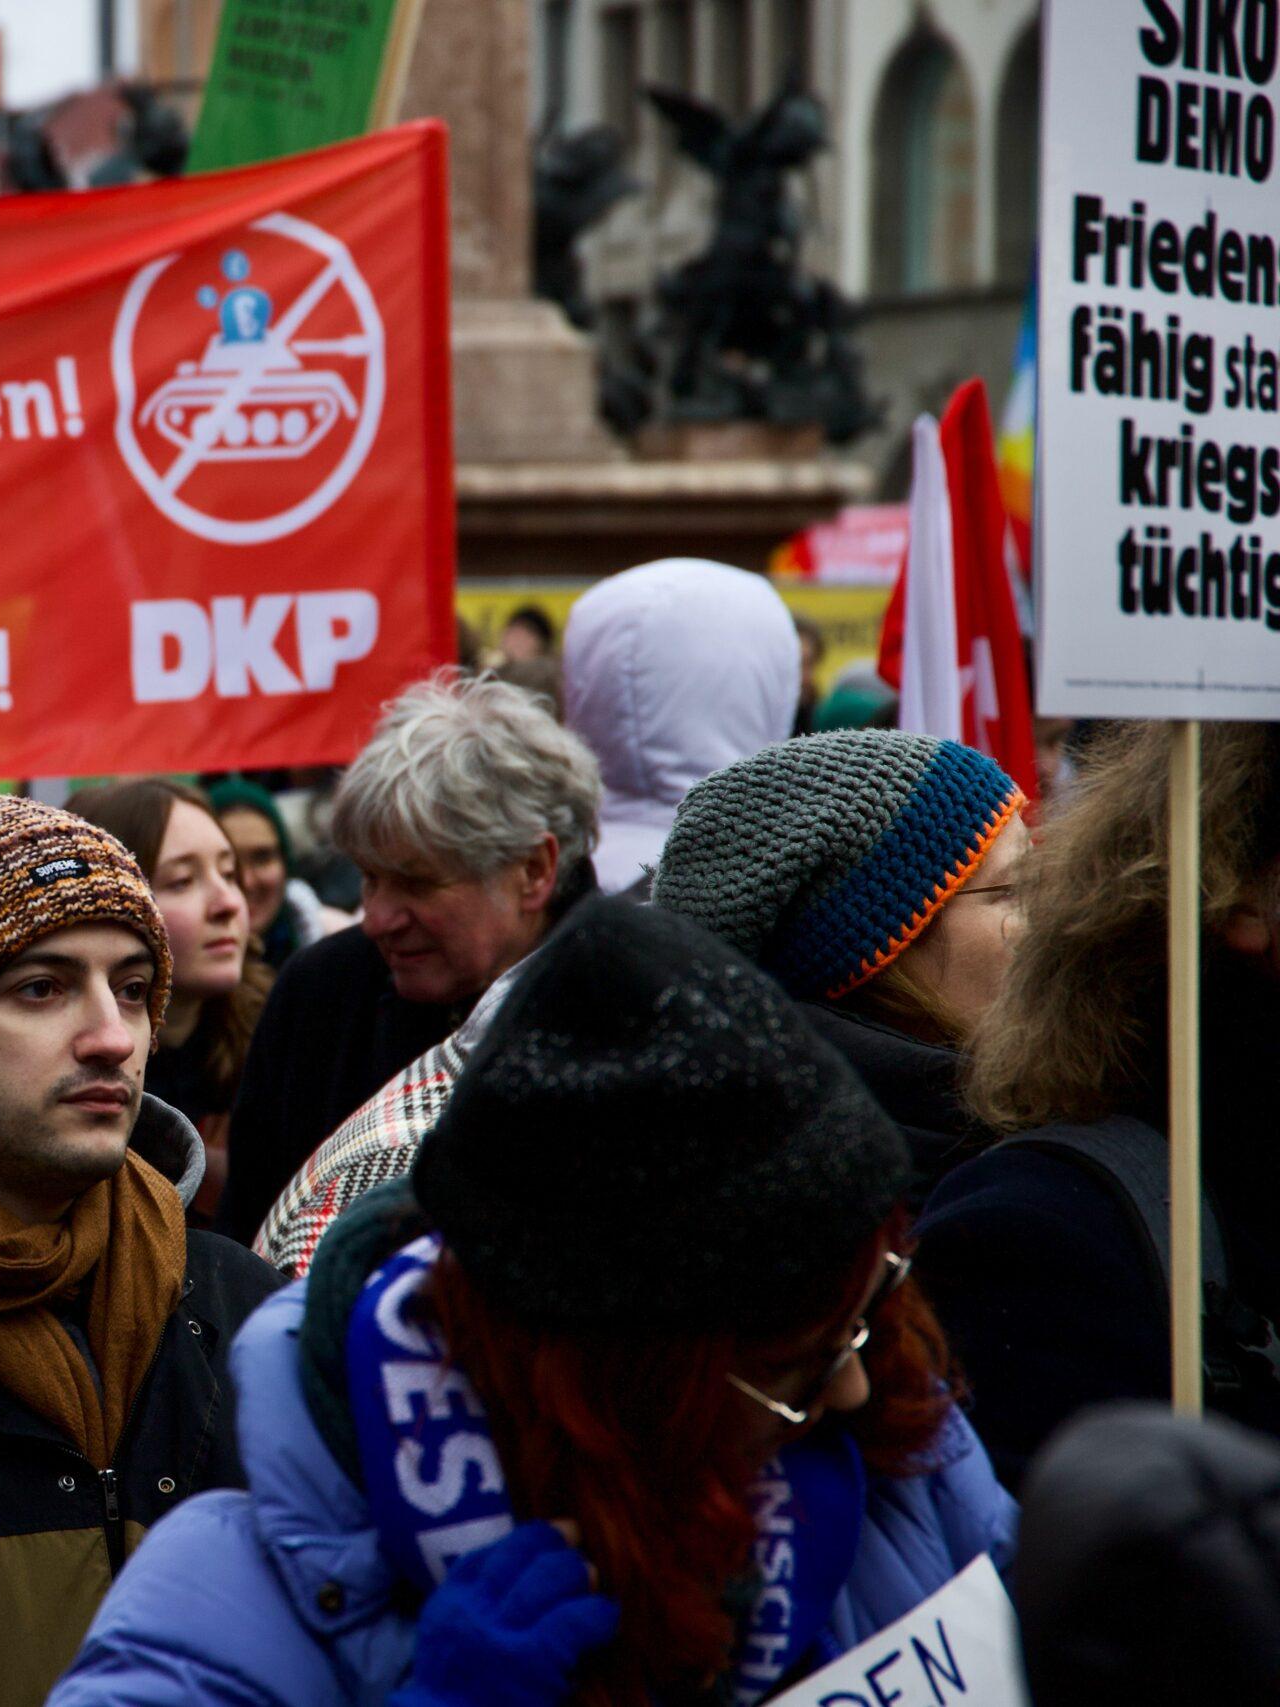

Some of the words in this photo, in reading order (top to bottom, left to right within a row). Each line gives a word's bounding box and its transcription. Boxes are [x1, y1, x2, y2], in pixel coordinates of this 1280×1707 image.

[1138, 0, 1280, 86] SIKO
[1136, 75, 1275, 183] DEMO
[1073, 194, 1280, 307] Frieden
[1070, 305, 1214, 415] fähig
[130, 590, 378, 704] DKP
